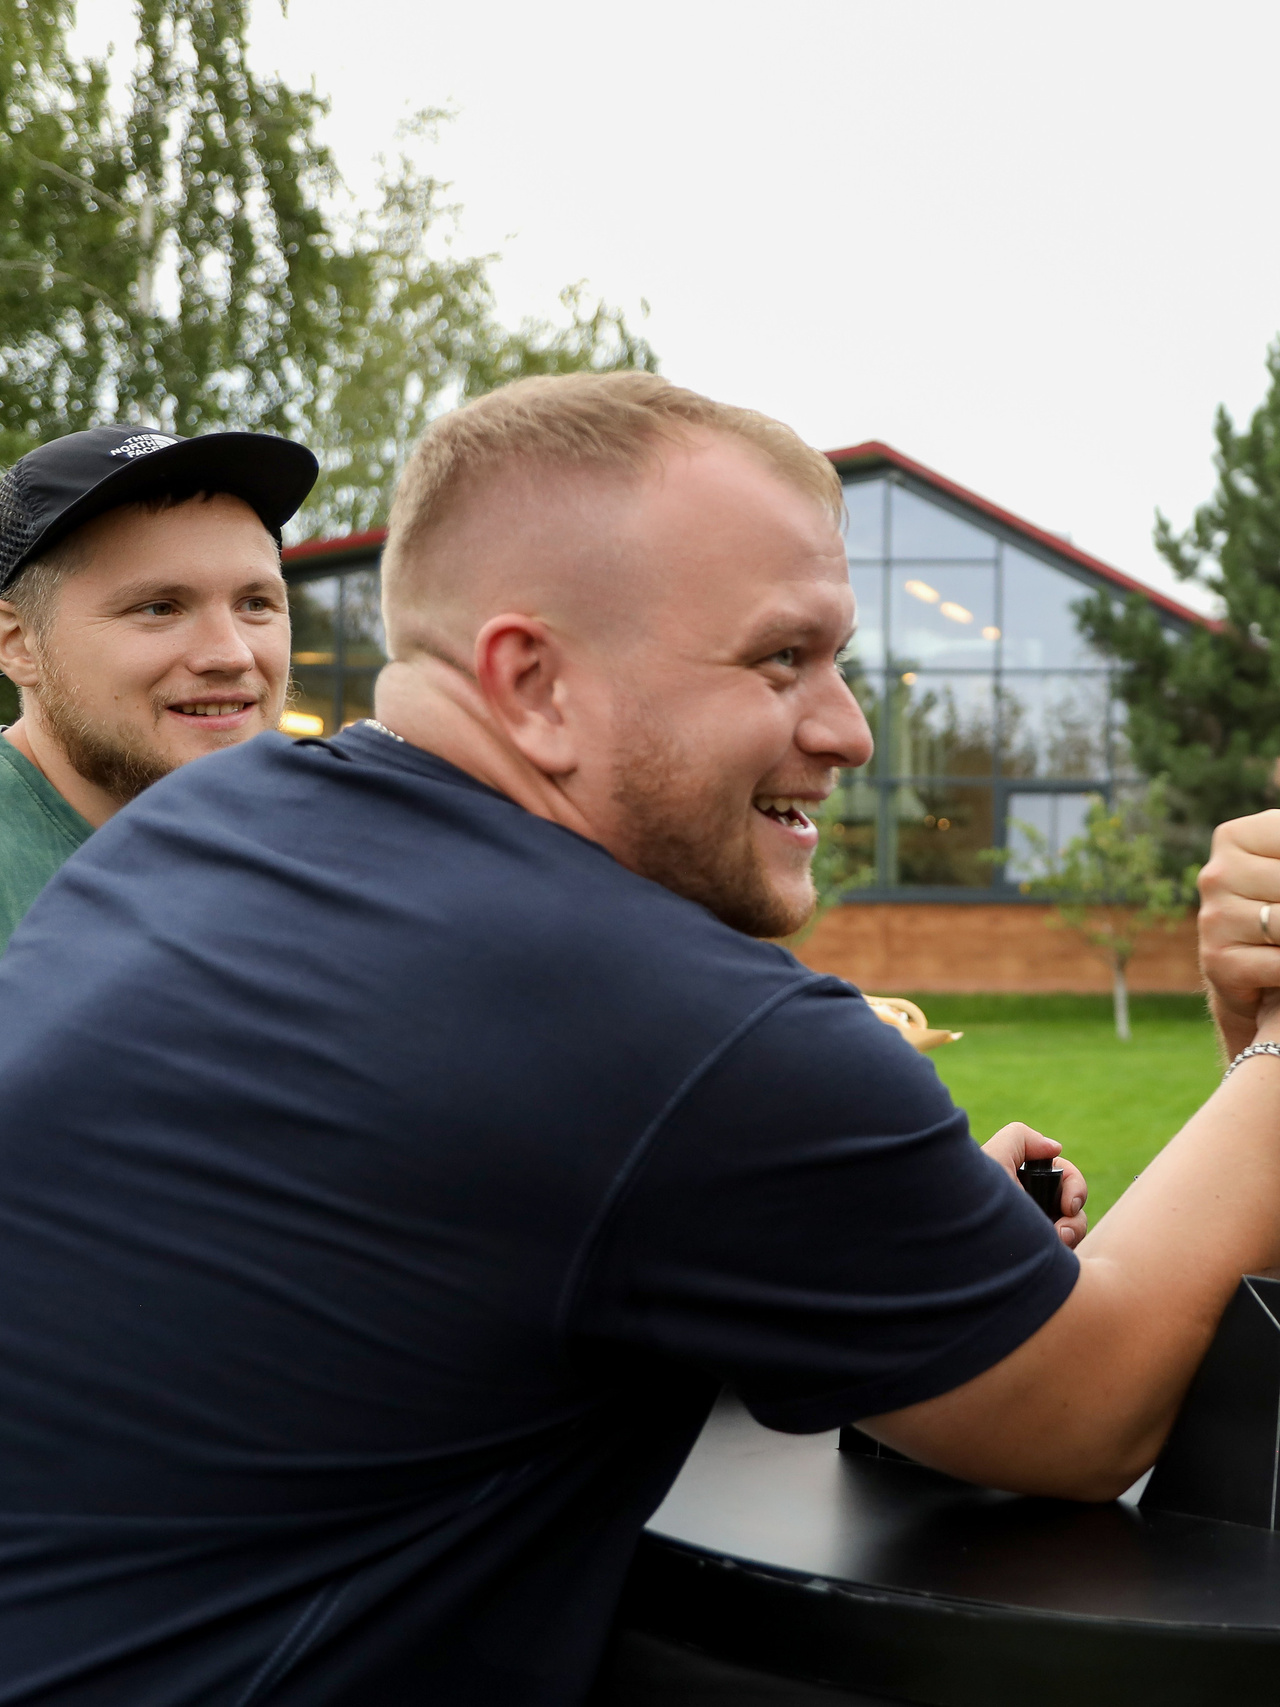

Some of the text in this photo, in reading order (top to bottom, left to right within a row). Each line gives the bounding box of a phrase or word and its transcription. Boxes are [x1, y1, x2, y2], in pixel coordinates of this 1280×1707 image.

[124, 434, 150, 444] THE
[110, 440, 156, 456] NORTH
[127, 446, 160, 458] FACE
